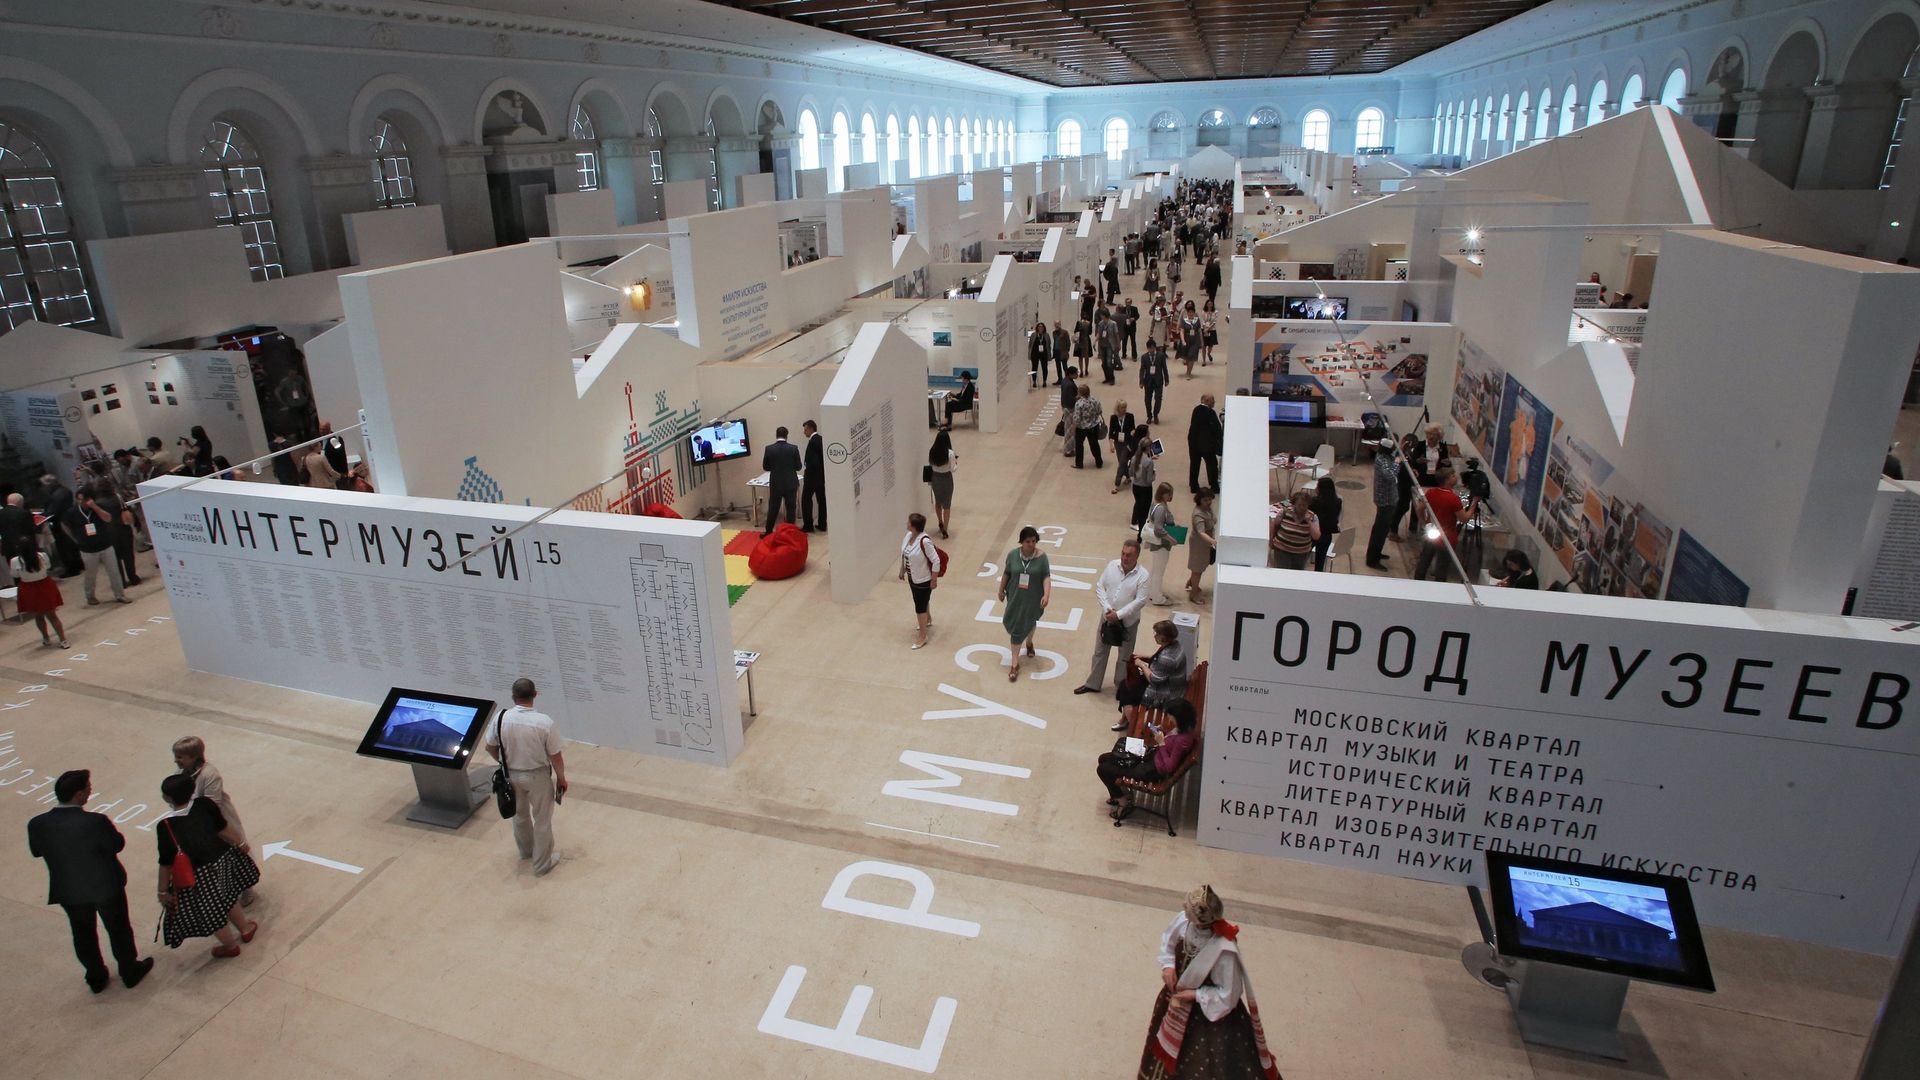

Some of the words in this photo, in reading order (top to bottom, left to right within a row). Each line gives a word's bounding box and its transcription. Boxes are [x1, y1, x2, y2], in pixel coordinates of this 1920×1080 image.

[829, 449, 845, 457] ВДНХ
[152, 520, 204, 532] МЕЖДУНАРОДНЫЙ
[171, 532, 208, 543] ФЕСТИВАЛЬ
[202, 506, 340, 559] ИНТЕР
[358, 522, 520, 581] МУЗЕЙ
[533, 540, 562, 566] 15
[0, 615, 170, 711] КВАРТАЛ
[1232, 611, 1472, 697] ГОРОД
[1540, 640, 1911, 730] МУЗЕЕВ
[1229, 684, 1270, 695] КВАРТАЛЫ
[1226, 726, 1328, 754] КВАРТАЛ
[1345, 740, 1437, 768] МУЗЫКИ
[1454, 754, 1469, 771] И
[1488, 758, 1585, 786] ТЕАТРА
[1293, 708, 1449, 742] МОСКОВСКИЙ
[1466, 729, 1582, 757] КВАРТАЛ
[1284, 784, 1467, 823] ЛИТЕРАТУРНЫЙ
[1484, 811, 1599, 841] КВАРТАЛ
[1288, 759, 1472, 798] ИСТОРИЧЕСКИЙ
[1489, 785, 1604, 814] КВАРТАЛ
[1219, 799, 1319, 827] КВАРТАЛ
[1335, 815, 1582, 863] ИЗОБРАЗИТЕЛЬНОГО
[1602, 852, 1758, 892] ИСКУССТВА
[1280, 831, 1381, 859] КВАРТАЛ
[1397, 848, 1473, 874] НАУКИ
[1568, 877, 1581, 887] 15
